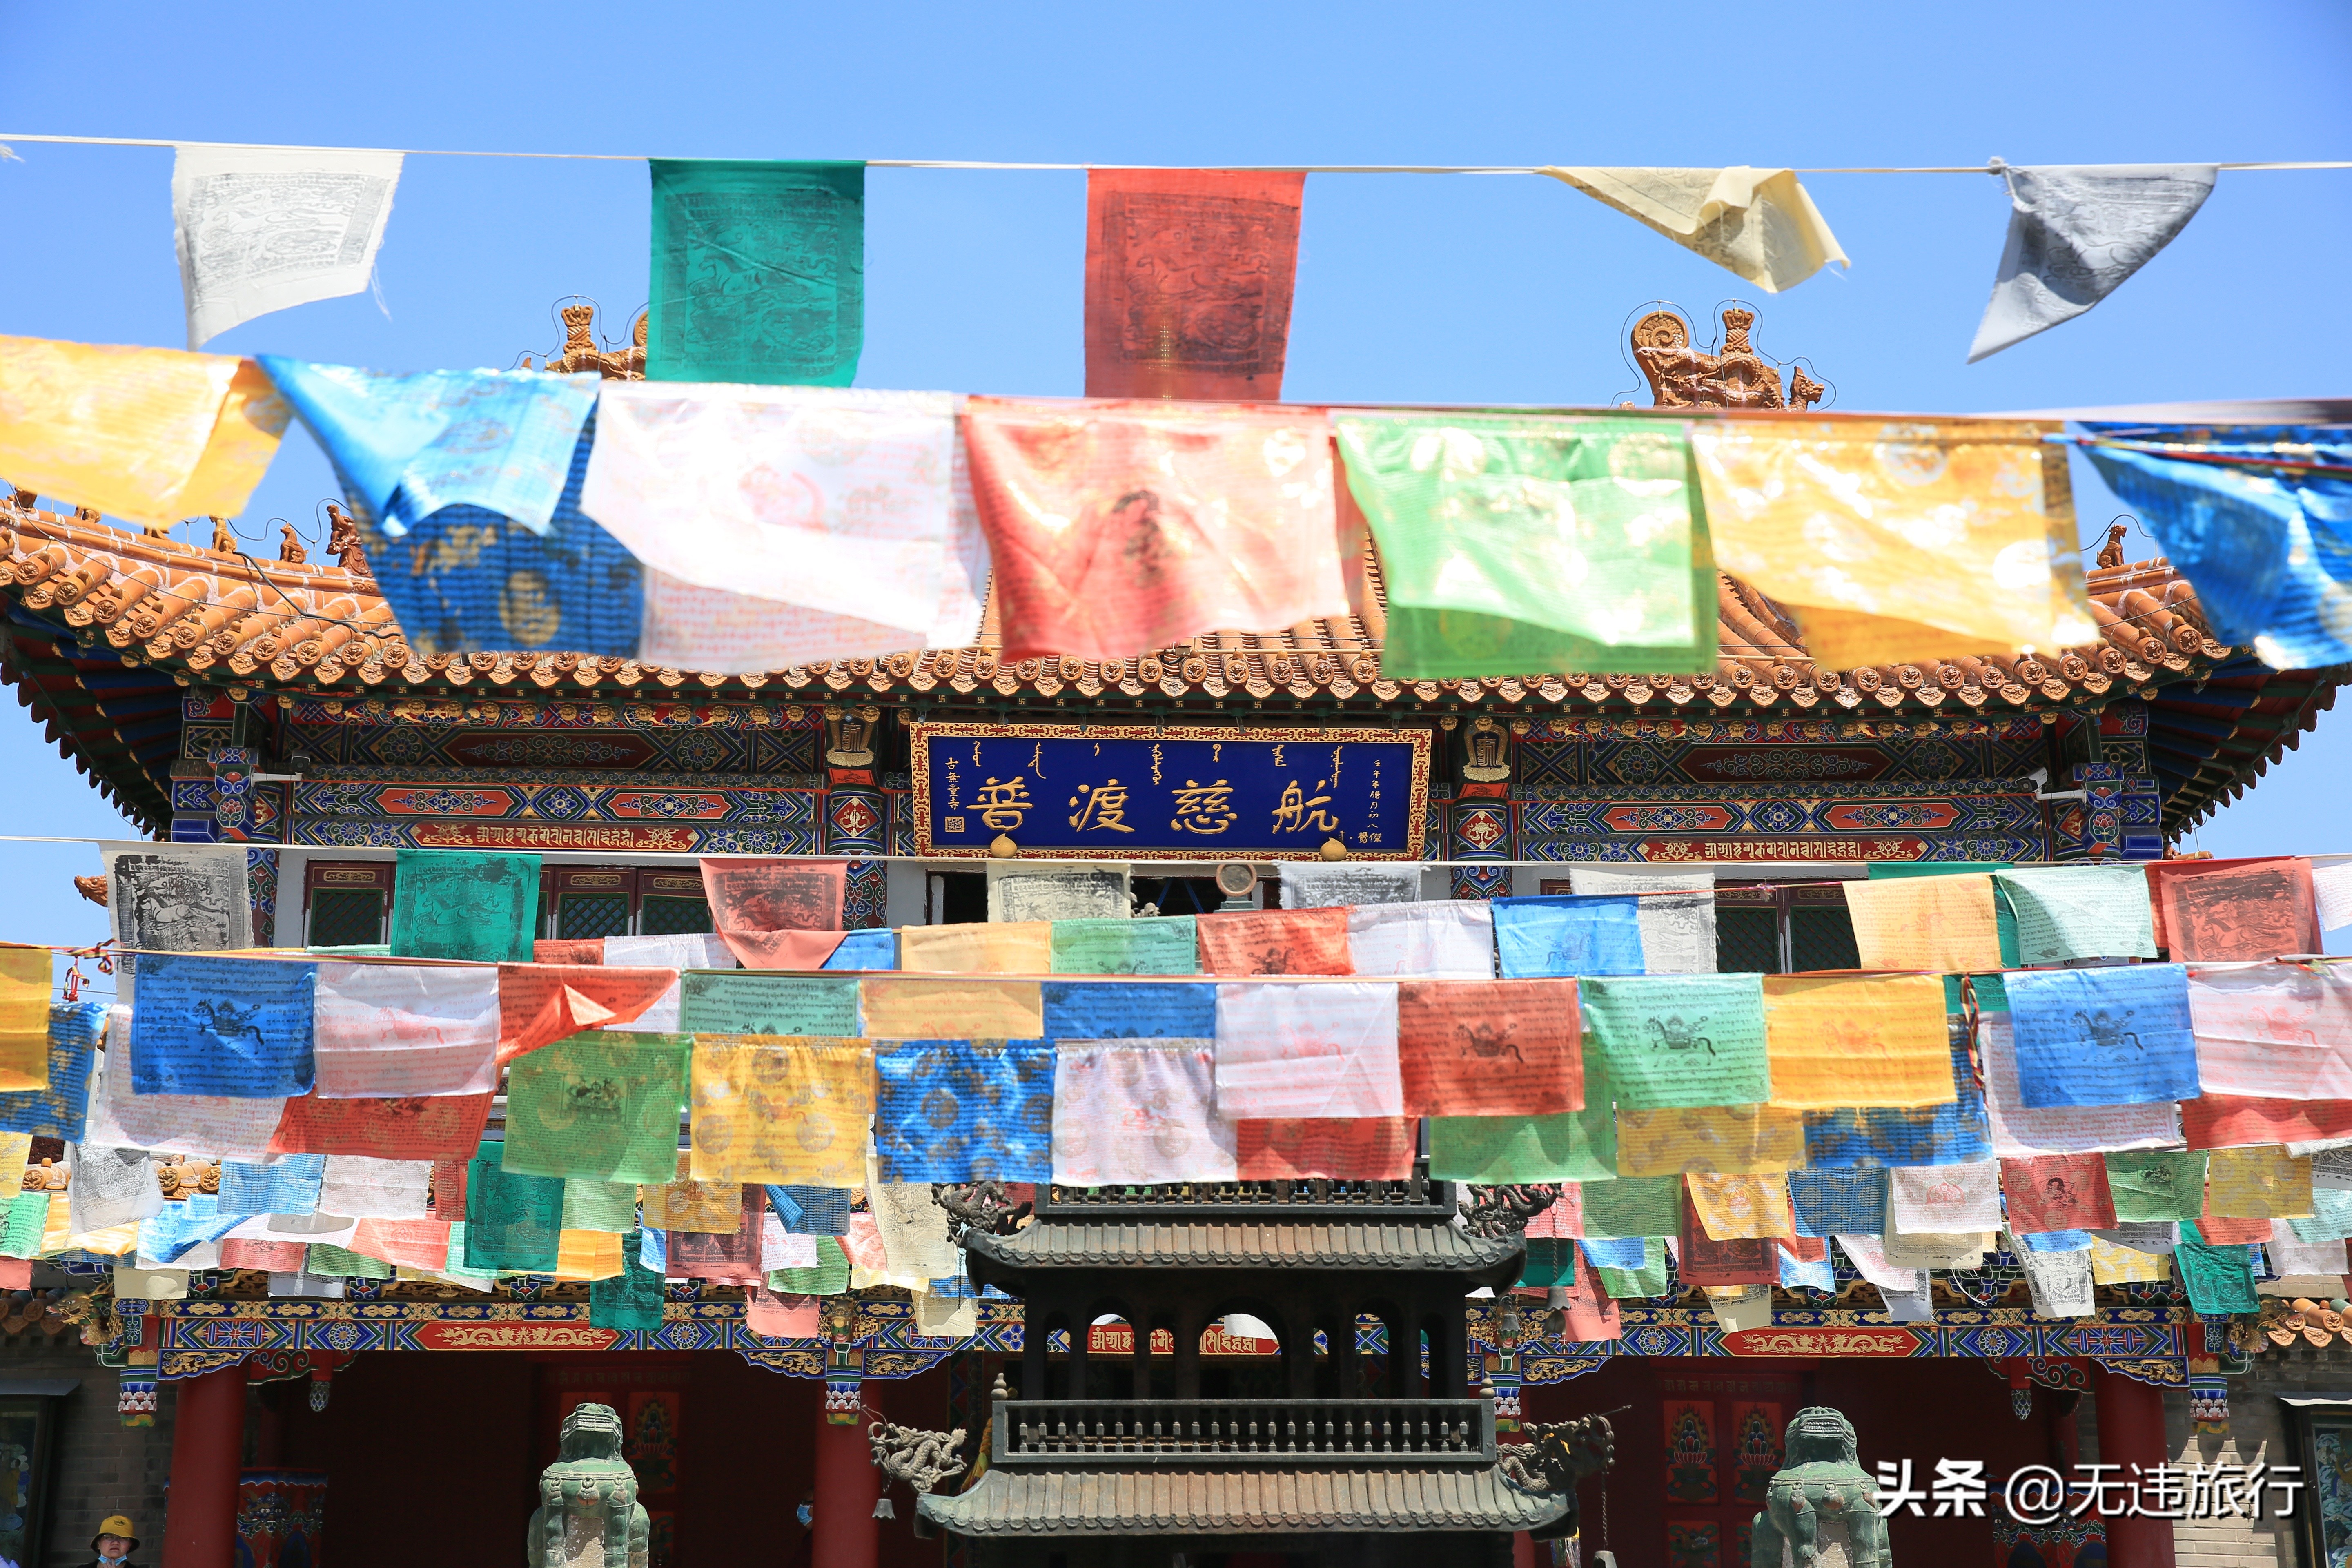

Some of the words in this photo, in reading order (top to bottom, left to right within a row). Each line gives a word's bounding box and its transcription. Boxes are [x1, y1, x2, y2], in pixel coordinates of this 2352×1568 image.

[945, 757, 961, 811] 古無量寺
[966, 775, 1339, 835] 普渡慈航
